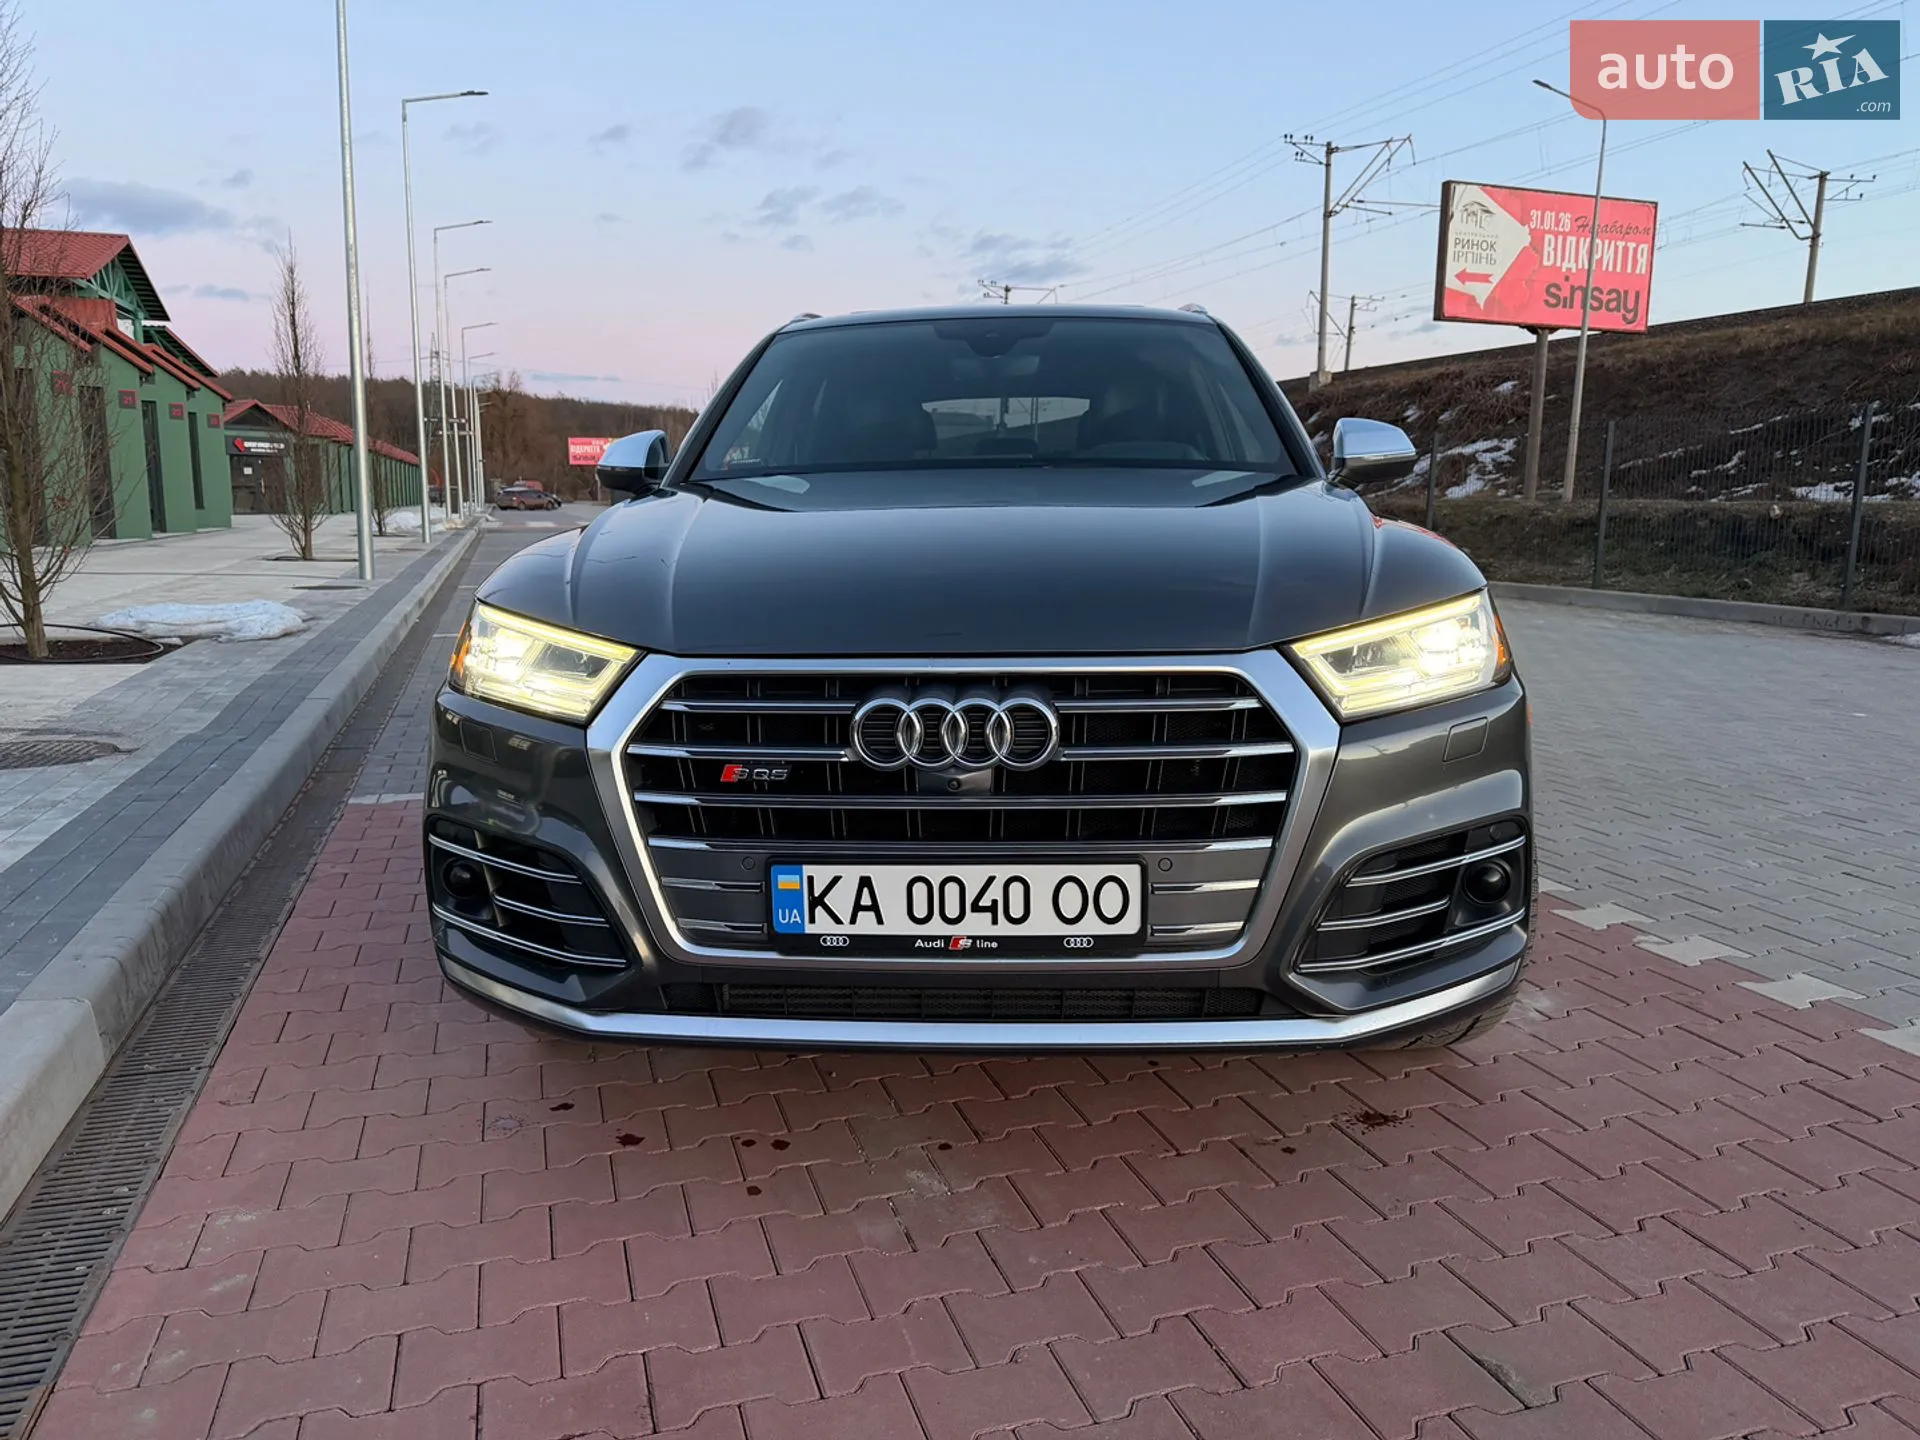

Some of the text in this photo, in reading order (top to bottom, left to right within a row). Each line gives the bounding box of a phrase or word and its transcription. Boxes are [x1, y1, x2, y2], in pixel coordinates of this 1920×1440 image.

[1530, 209, 1572, 232] 31.01.26
[1453, 237, 1497, 252] РИНОК
[1453, 250, 1497, 266] ІРПІНЬ
[1543, 233, 1649, 275] ВІДКРИТТЯ
[1544, 275, 1640, 325] sinsay
[731, 766, 789, 781] SQ5
[807, 875, 1130, 926] KA 0040 OO
[778, 909, 801, 923] UA
[914, 939, 945, 948] Audi
[976, 939, 998, 948] line
